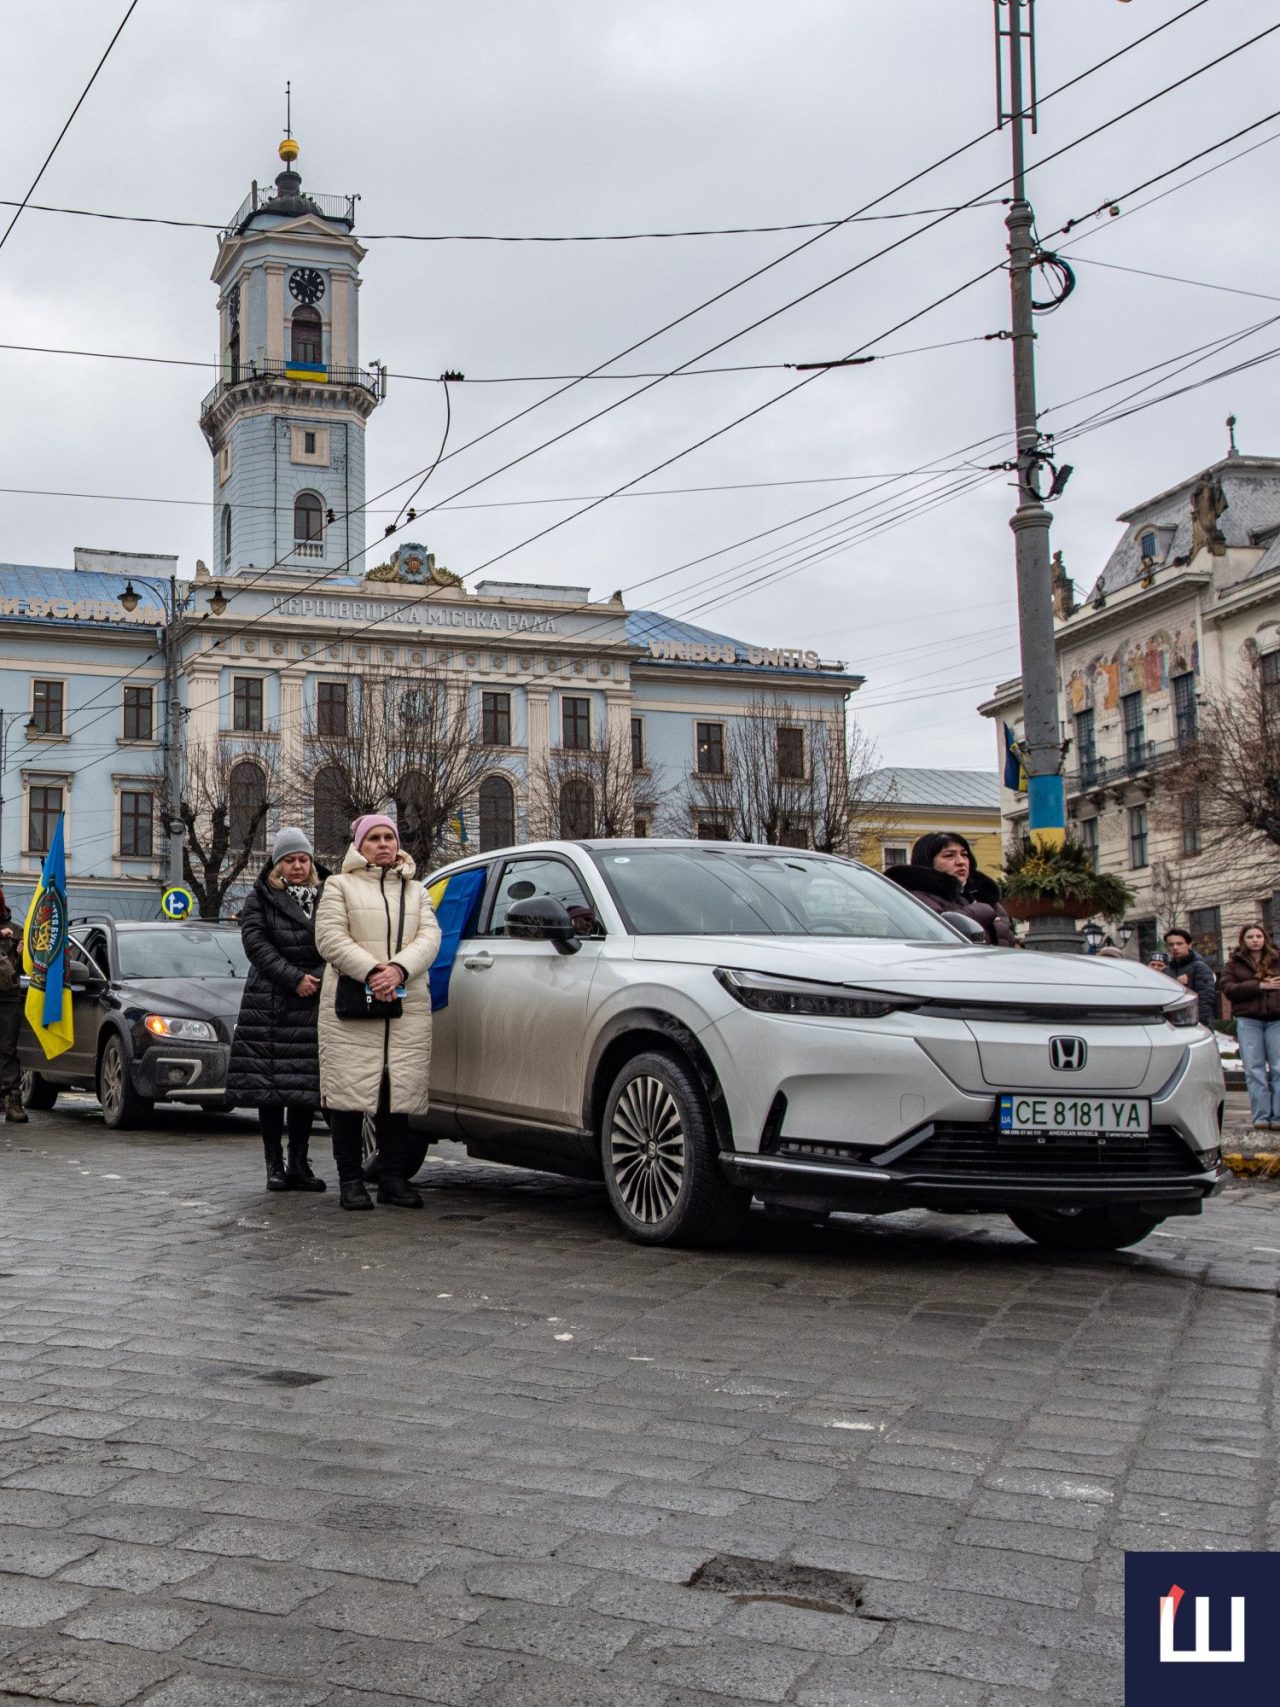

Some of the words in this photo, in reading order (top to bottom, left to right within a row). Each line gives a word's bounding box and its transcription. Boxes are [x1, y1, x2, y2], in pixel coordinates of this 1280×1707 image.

[271, 597, 421, 625] ЧЕРНІВЕЦЬКА
[426, 607, 501, 630] МІСЬКА
[506, 614, 558, 634] РАДА
[647, 639, 736, 664] VIRIBUS
[746, 646, 819, 669] UNITIS
[1001, 1115, 1011, 1124] UA
[1015, 1100, 1047, 1125] CE
[1053, 1101, 1104, 1127] 8181
[1111, 1103, 1141, 1128] YA
